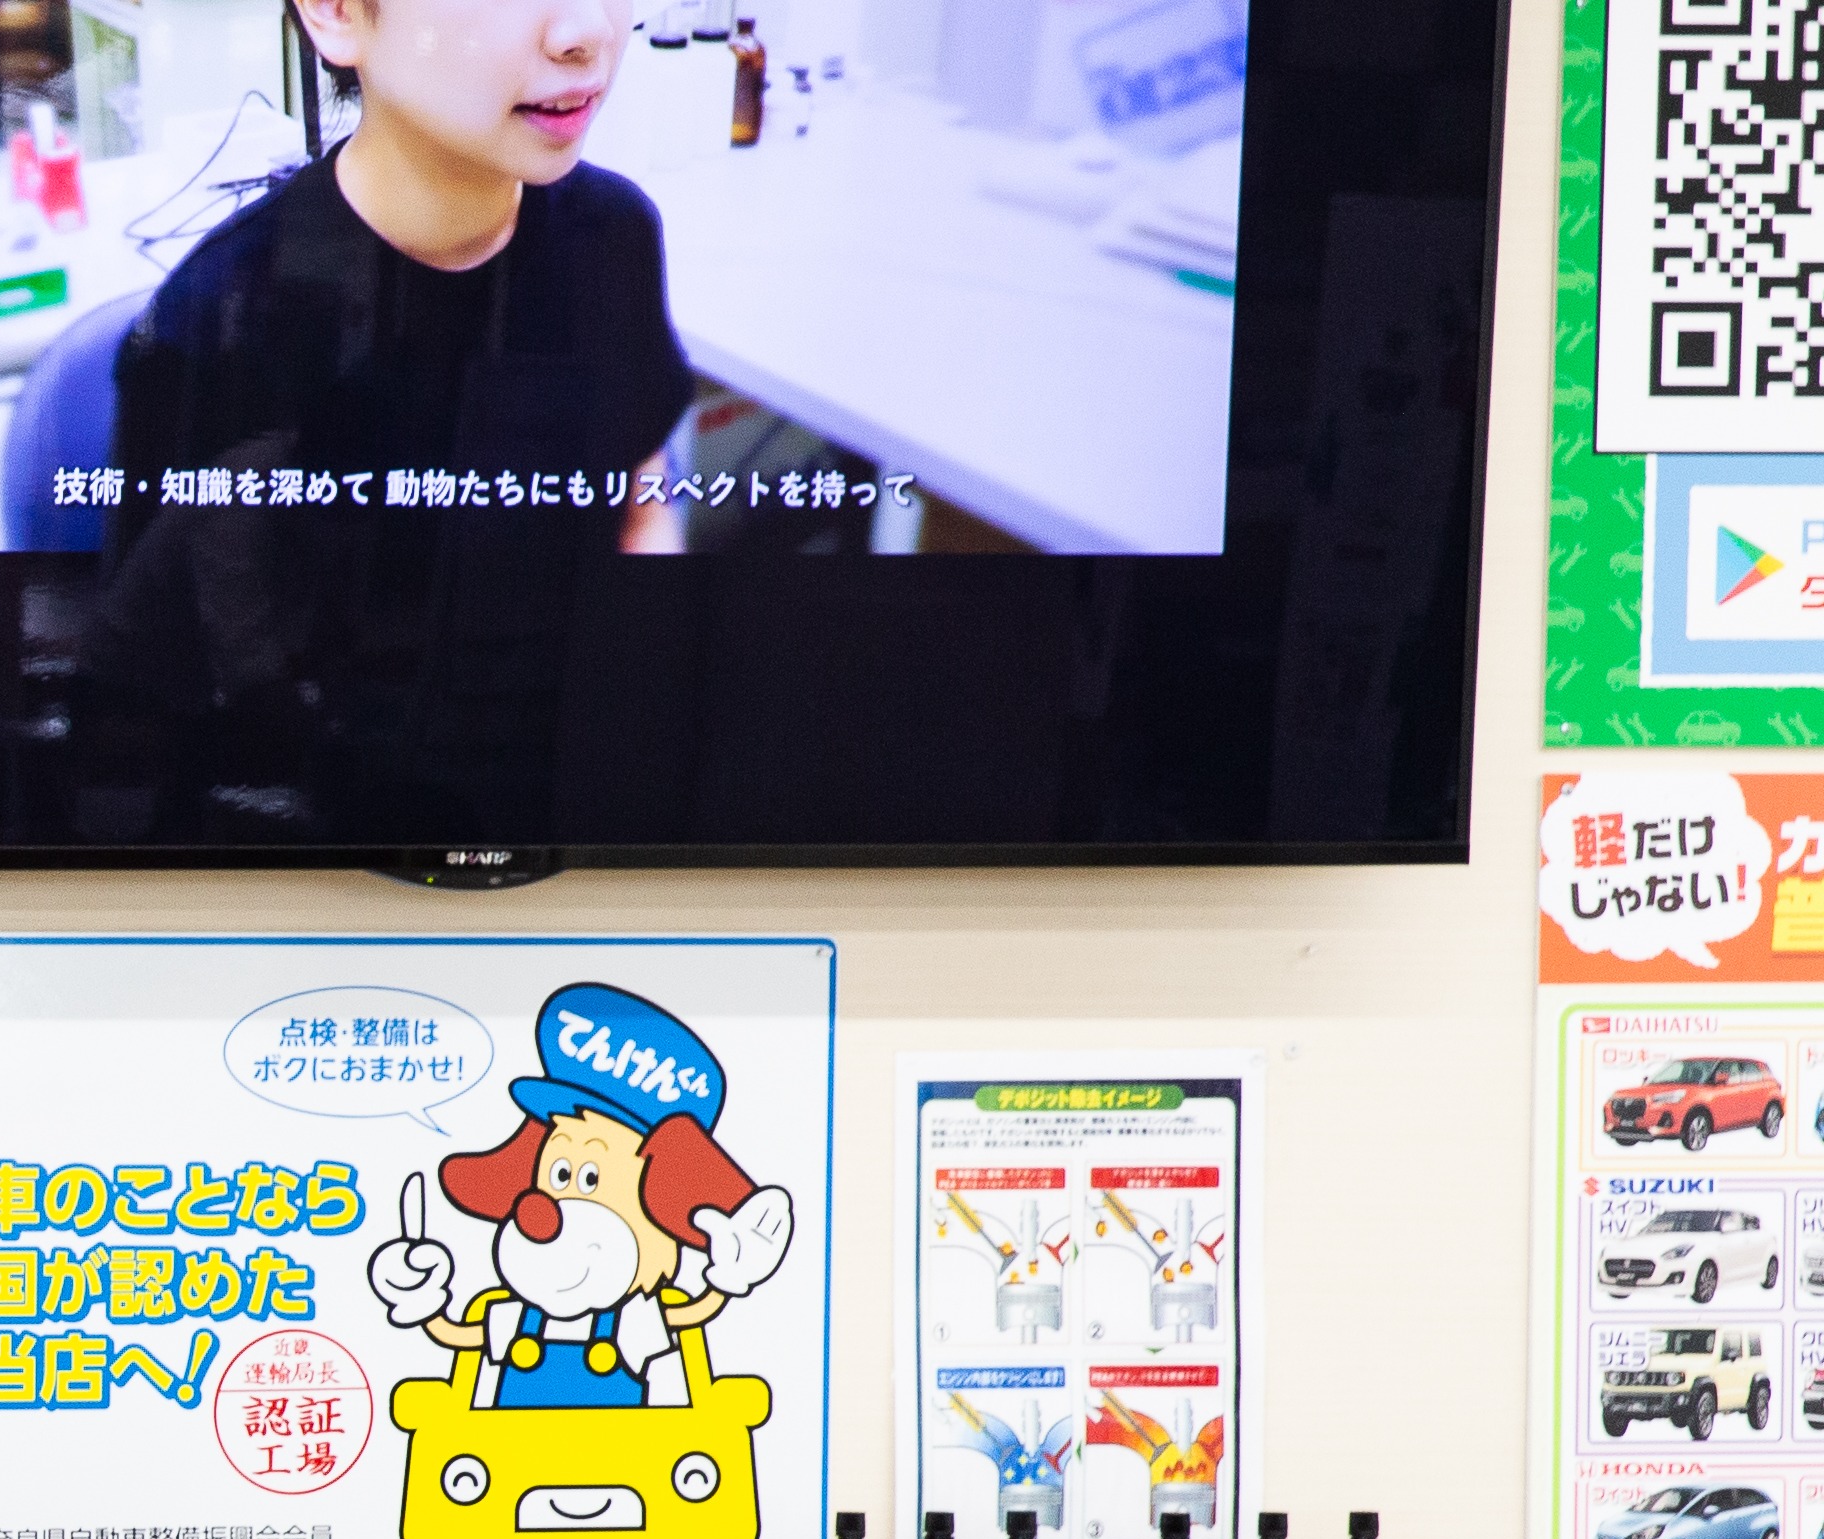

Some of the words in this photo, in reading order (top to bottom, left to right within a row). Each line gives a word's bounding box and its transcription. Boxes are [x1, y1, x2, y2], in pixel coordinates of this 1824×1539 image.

[53, 466, 374, 508] 技術・知識を深めて
[385, 466, 917, 508] 動物たちにもリスペクトを持って
[1572, 813, 1715, 868] 軽だけ
[446, 851, 512, 864] SHARP
[1615, 1016, 1719, 1034] DAIHATSU
[555, 1008, 712, 1104] てんけんくん
[1602, 1047, 1674, 1065] ロッキー
[1609, 1178, 1715, 1195] SUZUKI
[1600, 1200, 1662, 1217] スイフト
[1600, 1219, 1626, 1235] HV
[273, 1337, 312, 1358] 近畿
[243, 1358, 341, 1387] 運輸局長
[242, 1396, 346, 1438] 認証
[252, 1440, 338, 1480] 工場
[1601, 1463, 1705, 1476] HONDA
